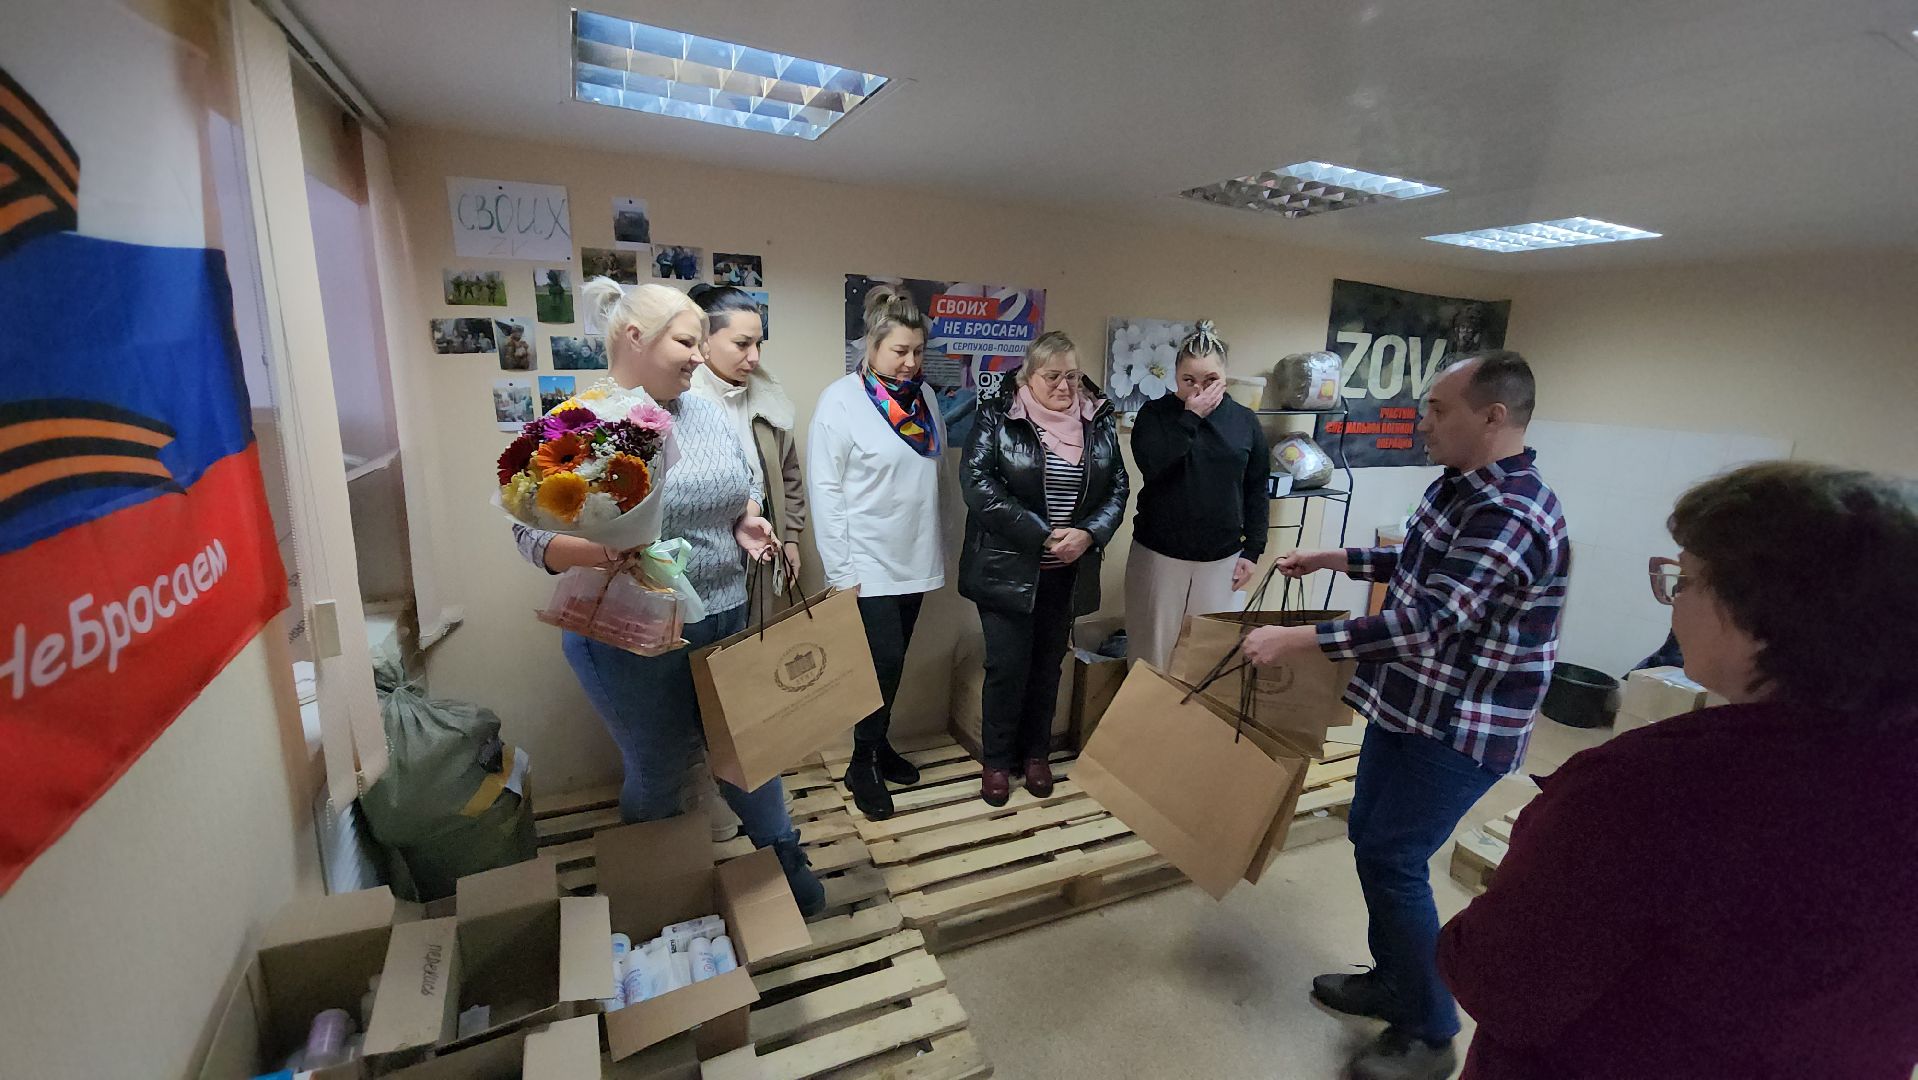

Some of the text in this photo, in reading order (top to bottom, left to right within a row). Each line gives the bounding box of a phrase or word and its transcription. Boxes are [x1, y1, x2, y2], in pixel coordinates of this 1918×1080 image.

[457, 193, 569, 240] СВОИХ
[936, 298, 989, 317] СВОИХ
[943, 321, 1028, 338] НЕ БРОСАЕМ
[952, 341, 1027, 354] СЕРПУХОВ-ПОДОЛ
[1337, 331, 1448, 400] ZOV
